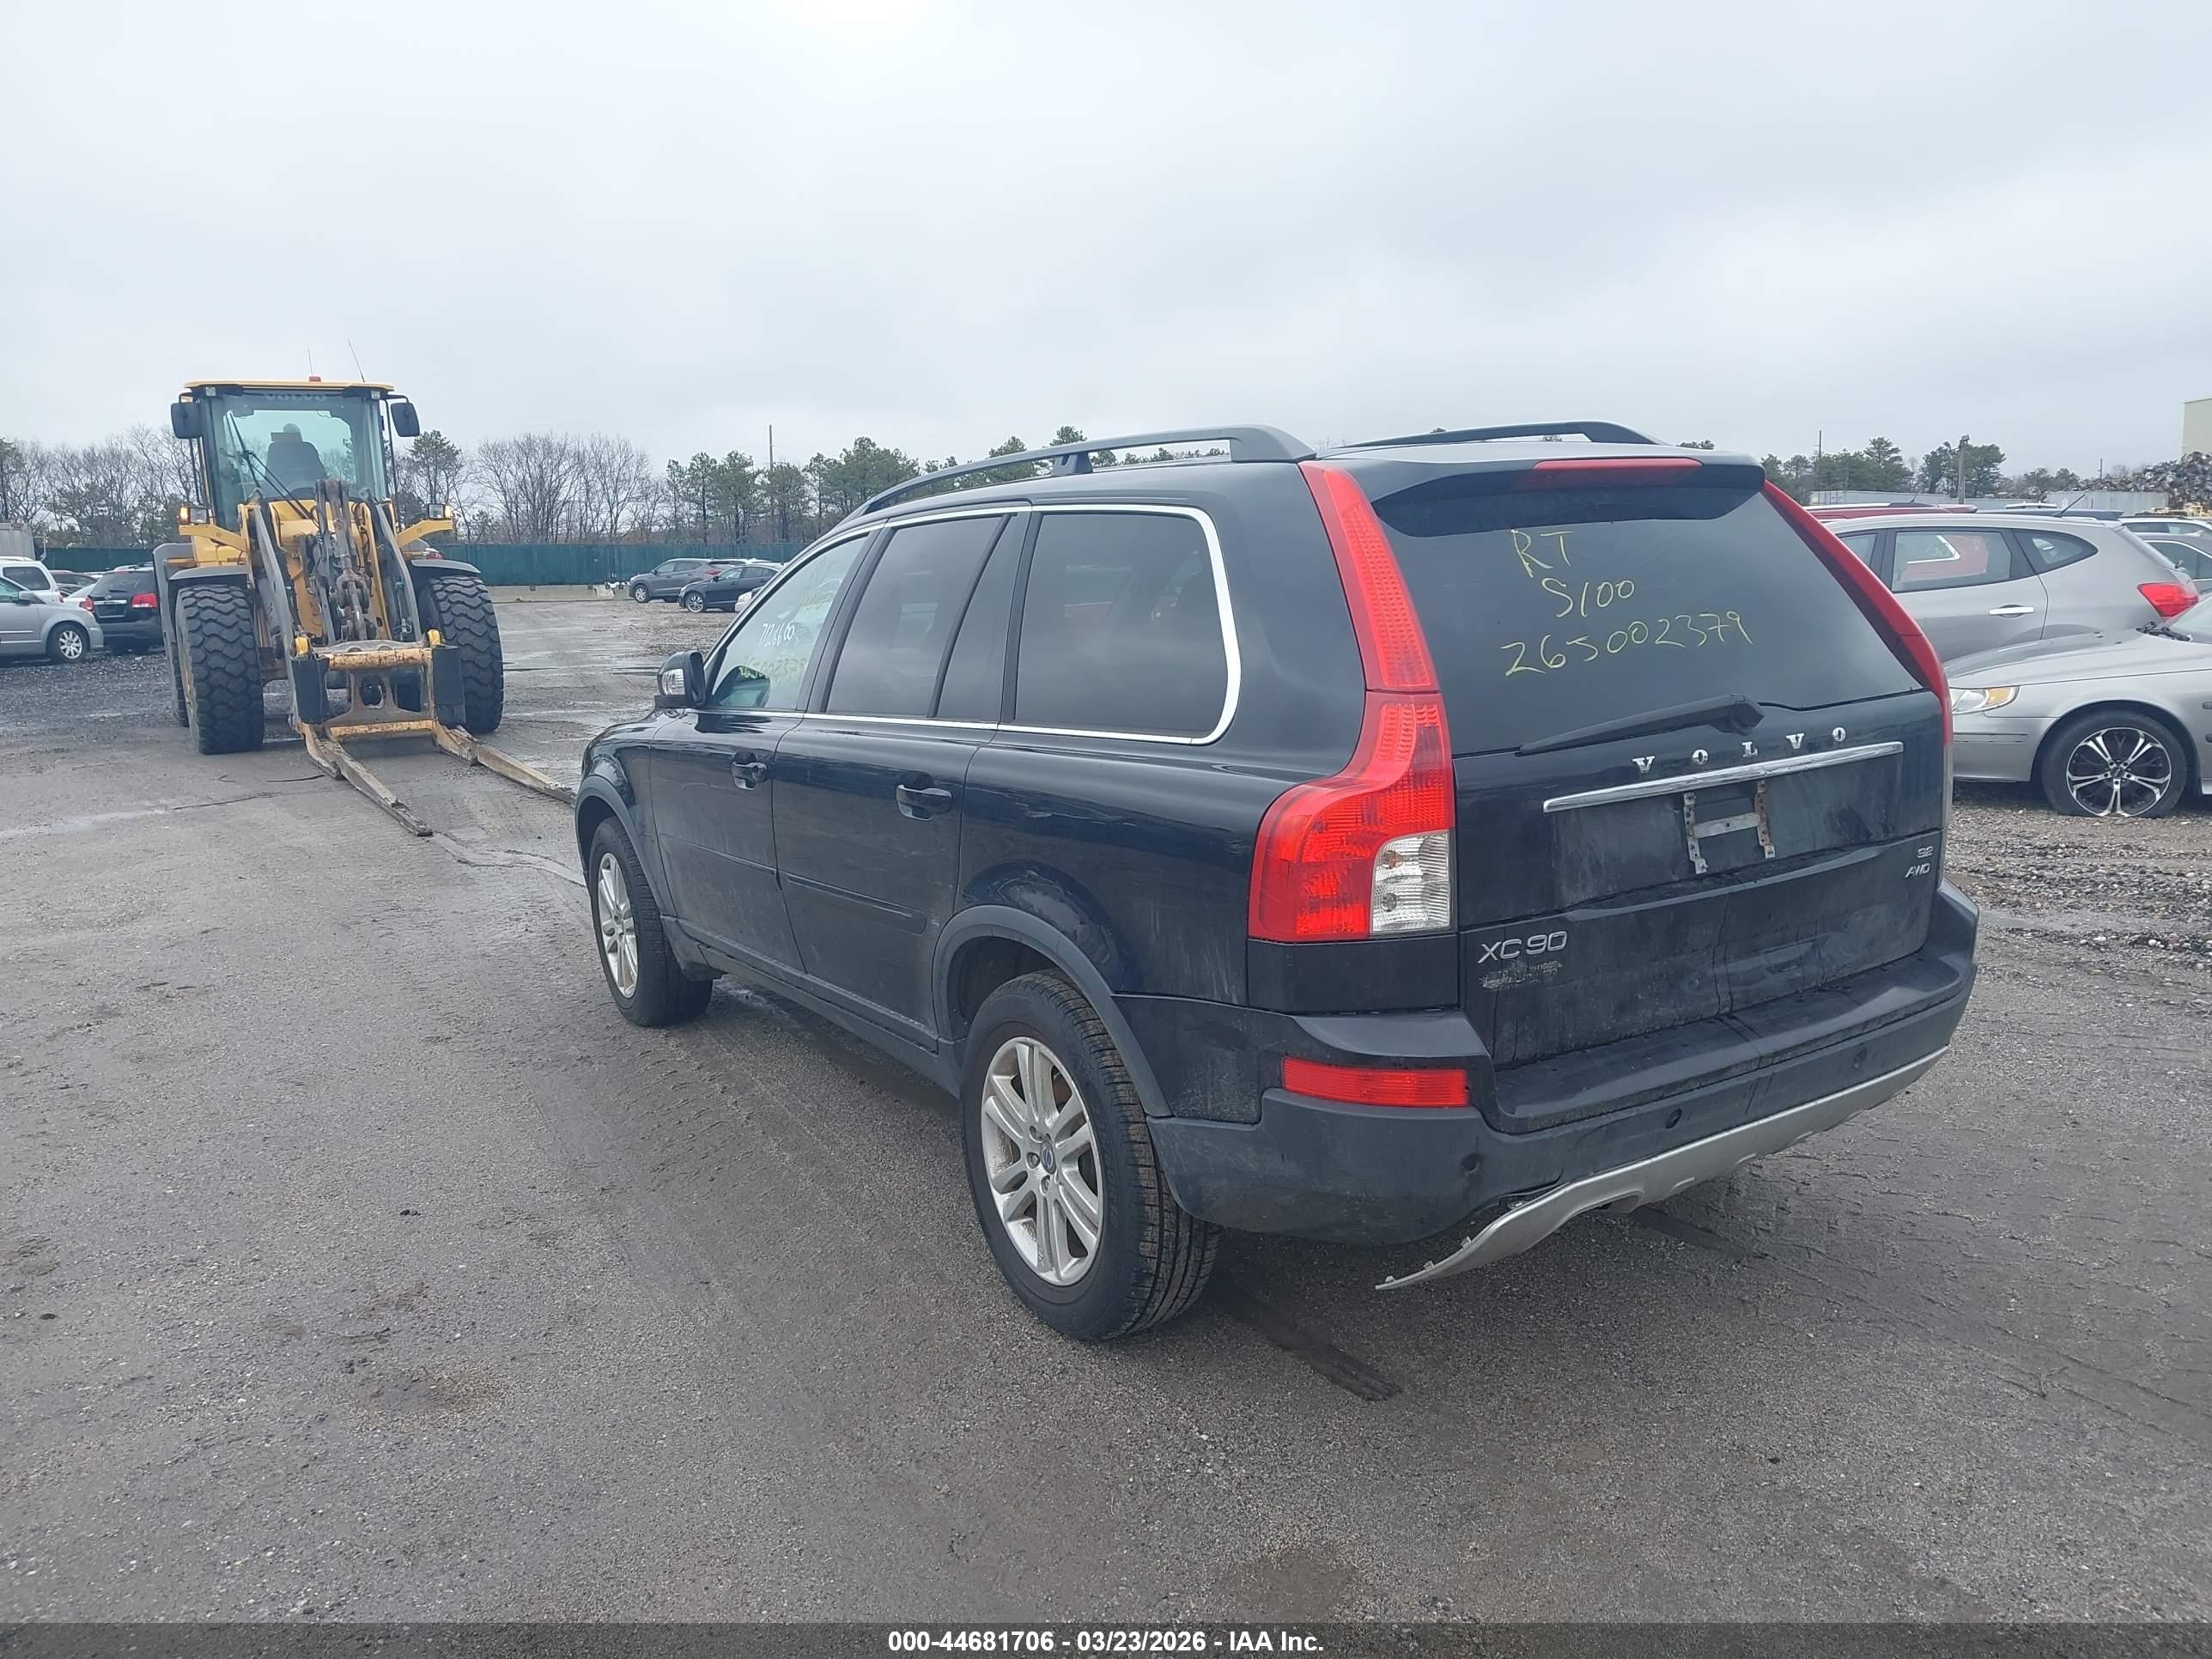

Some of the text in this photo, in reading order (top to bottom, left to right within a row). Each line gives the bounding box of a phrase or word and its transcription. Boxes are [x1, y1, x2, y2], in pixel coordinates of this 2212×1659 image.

[1510, 528, 1573, 577] RT
[1500, 611, 1753, 677] 265002379
[1632, 726, 1847, 774] VOLVO
[1905, 862, 1931, 878] AWD
[1477, 931, 1568, 963] XC90
